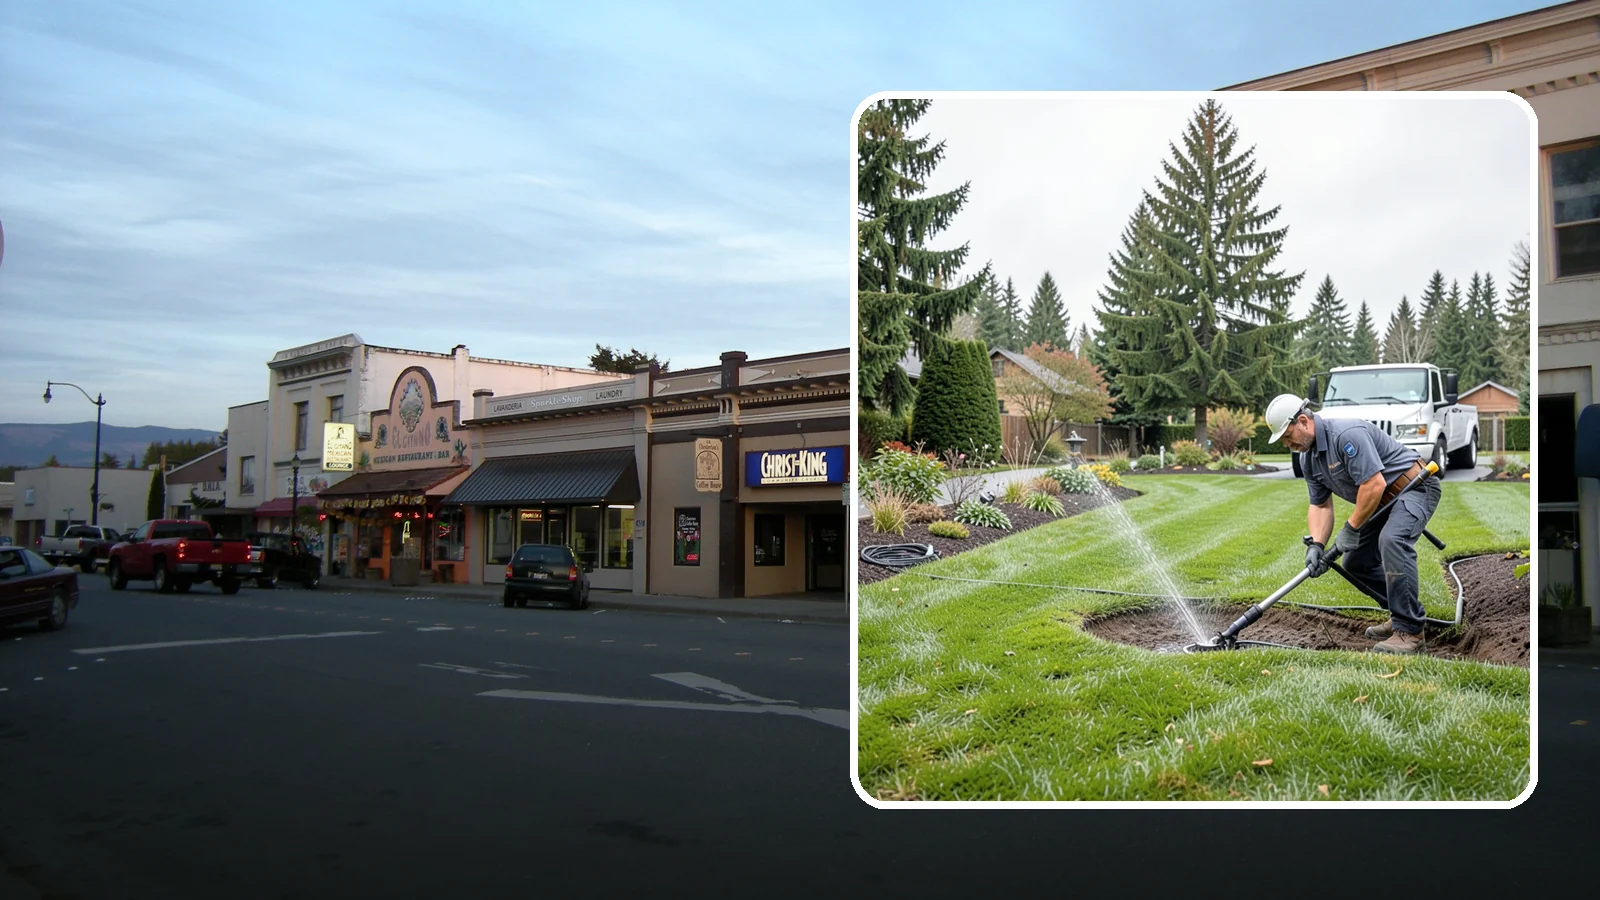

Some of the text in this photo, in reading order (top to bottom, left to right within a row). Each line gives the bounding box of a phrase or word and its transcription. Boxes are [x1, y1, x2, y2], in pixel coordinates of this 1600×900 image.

[531, 394, 583, 409] Sparkle Shop
[595, 389, 624, 400] LAUNDRY
[493, 402, 522, 413] LAVANDERIA
[373, 455, 396, 464] MEXICAN
[397, 451, 433, 462] RESTAURANT
[438, 450, 450, 459] BAR
[761, 450, 827, 478] CHRIST KING
